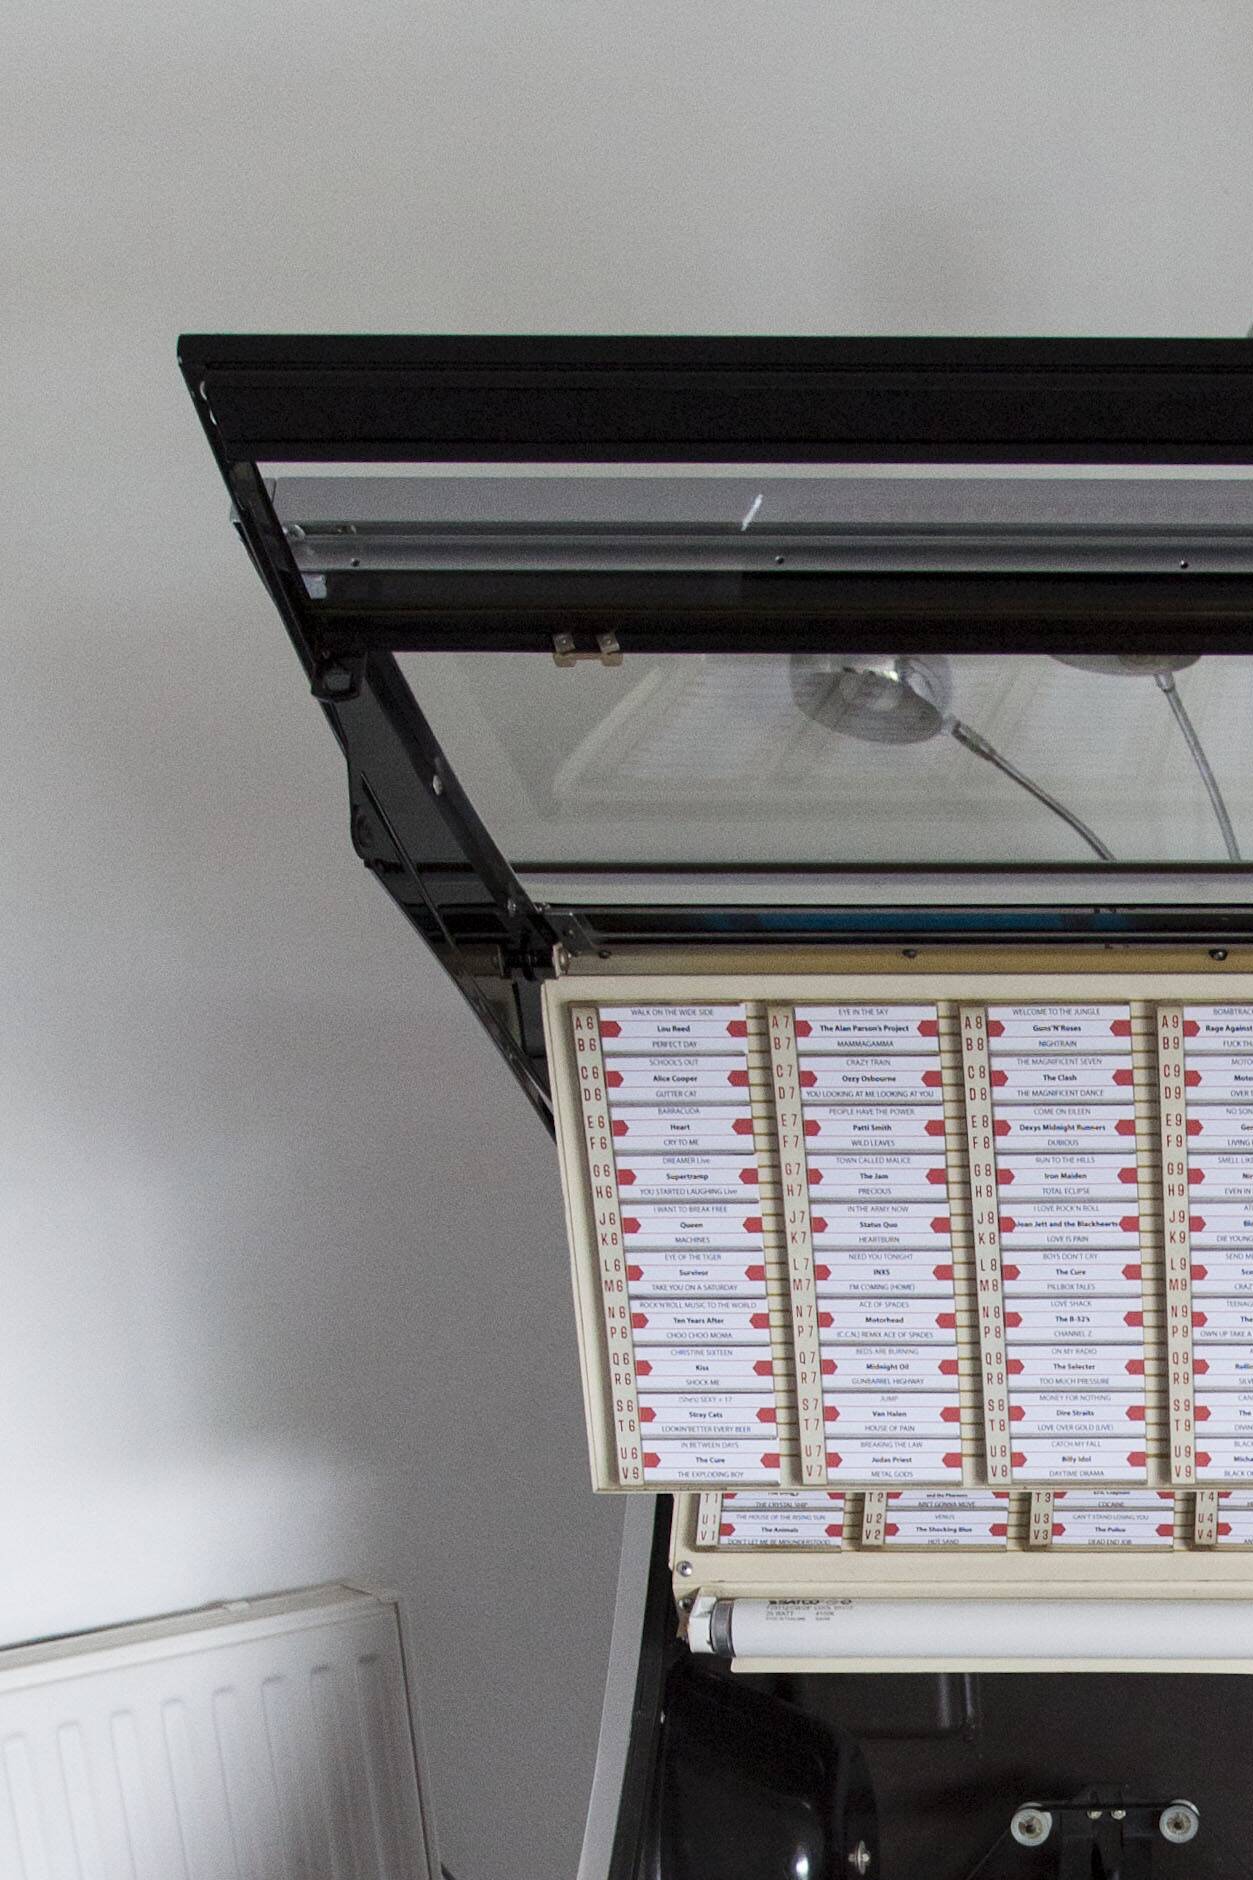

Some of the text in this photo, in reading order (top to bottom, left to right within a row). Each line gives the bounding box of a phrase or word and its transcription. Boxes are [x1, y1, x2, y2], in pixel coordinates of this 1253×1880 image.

[883, 1025, 910, 1033] Project
[1205, 1025, 1224, 1033] Rage
[1225, 1025, 1253, 1033] Against
[672, 1075, 698, 1083] Cooper
[861, 1075, 897, 1083] Osbourne
[1057, 1074, 1077, 1082] Clash
[853, 1124, 892, 1132] Patti Smith
[1019, 1124, 1041, 1132] Dexys
[1042, 1124, 1075, 1132] Midnight
[666, 1173, 709, 1181] Supertramp
[1044, 1172, 1088, 1180] Iron Maiden
[865, 1316, 904, 1324] Motorhead
[871, 1456, 891, 1464] Judas
